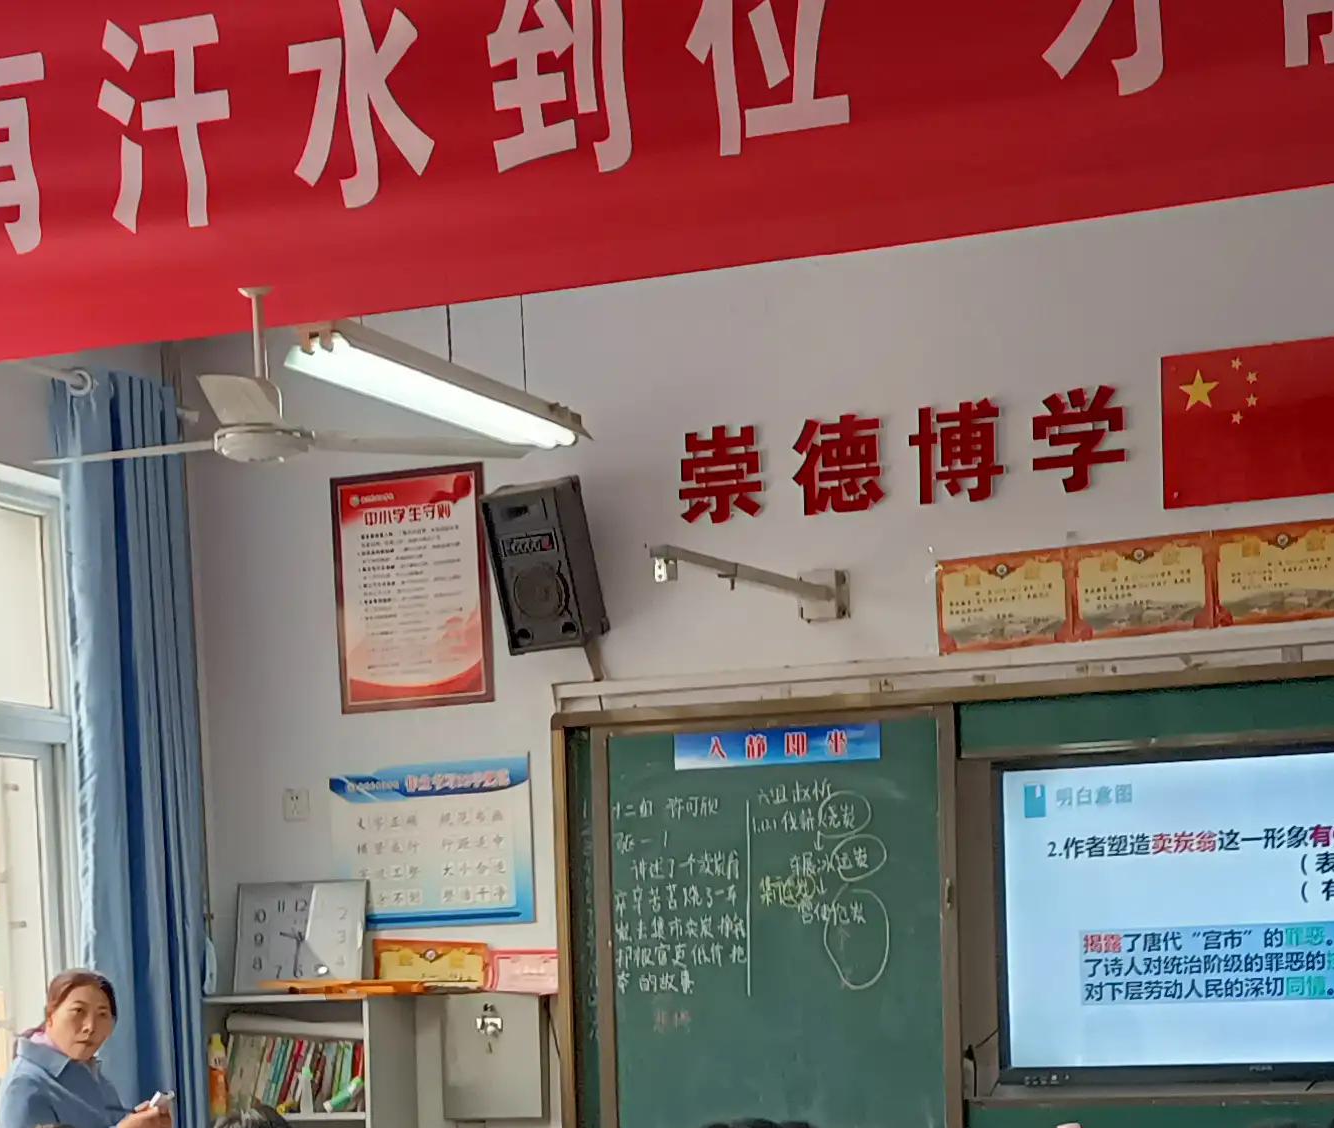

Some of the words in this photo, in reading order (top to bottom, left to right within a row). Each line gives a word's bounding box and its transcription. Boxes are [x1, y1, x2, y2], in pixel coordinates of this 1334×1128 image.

[679, 385, 1129, 524] 崇德博学
[363, 503, 454, 527] 中小学生守则
[1056, 783, 1133, 808] 明白意图
